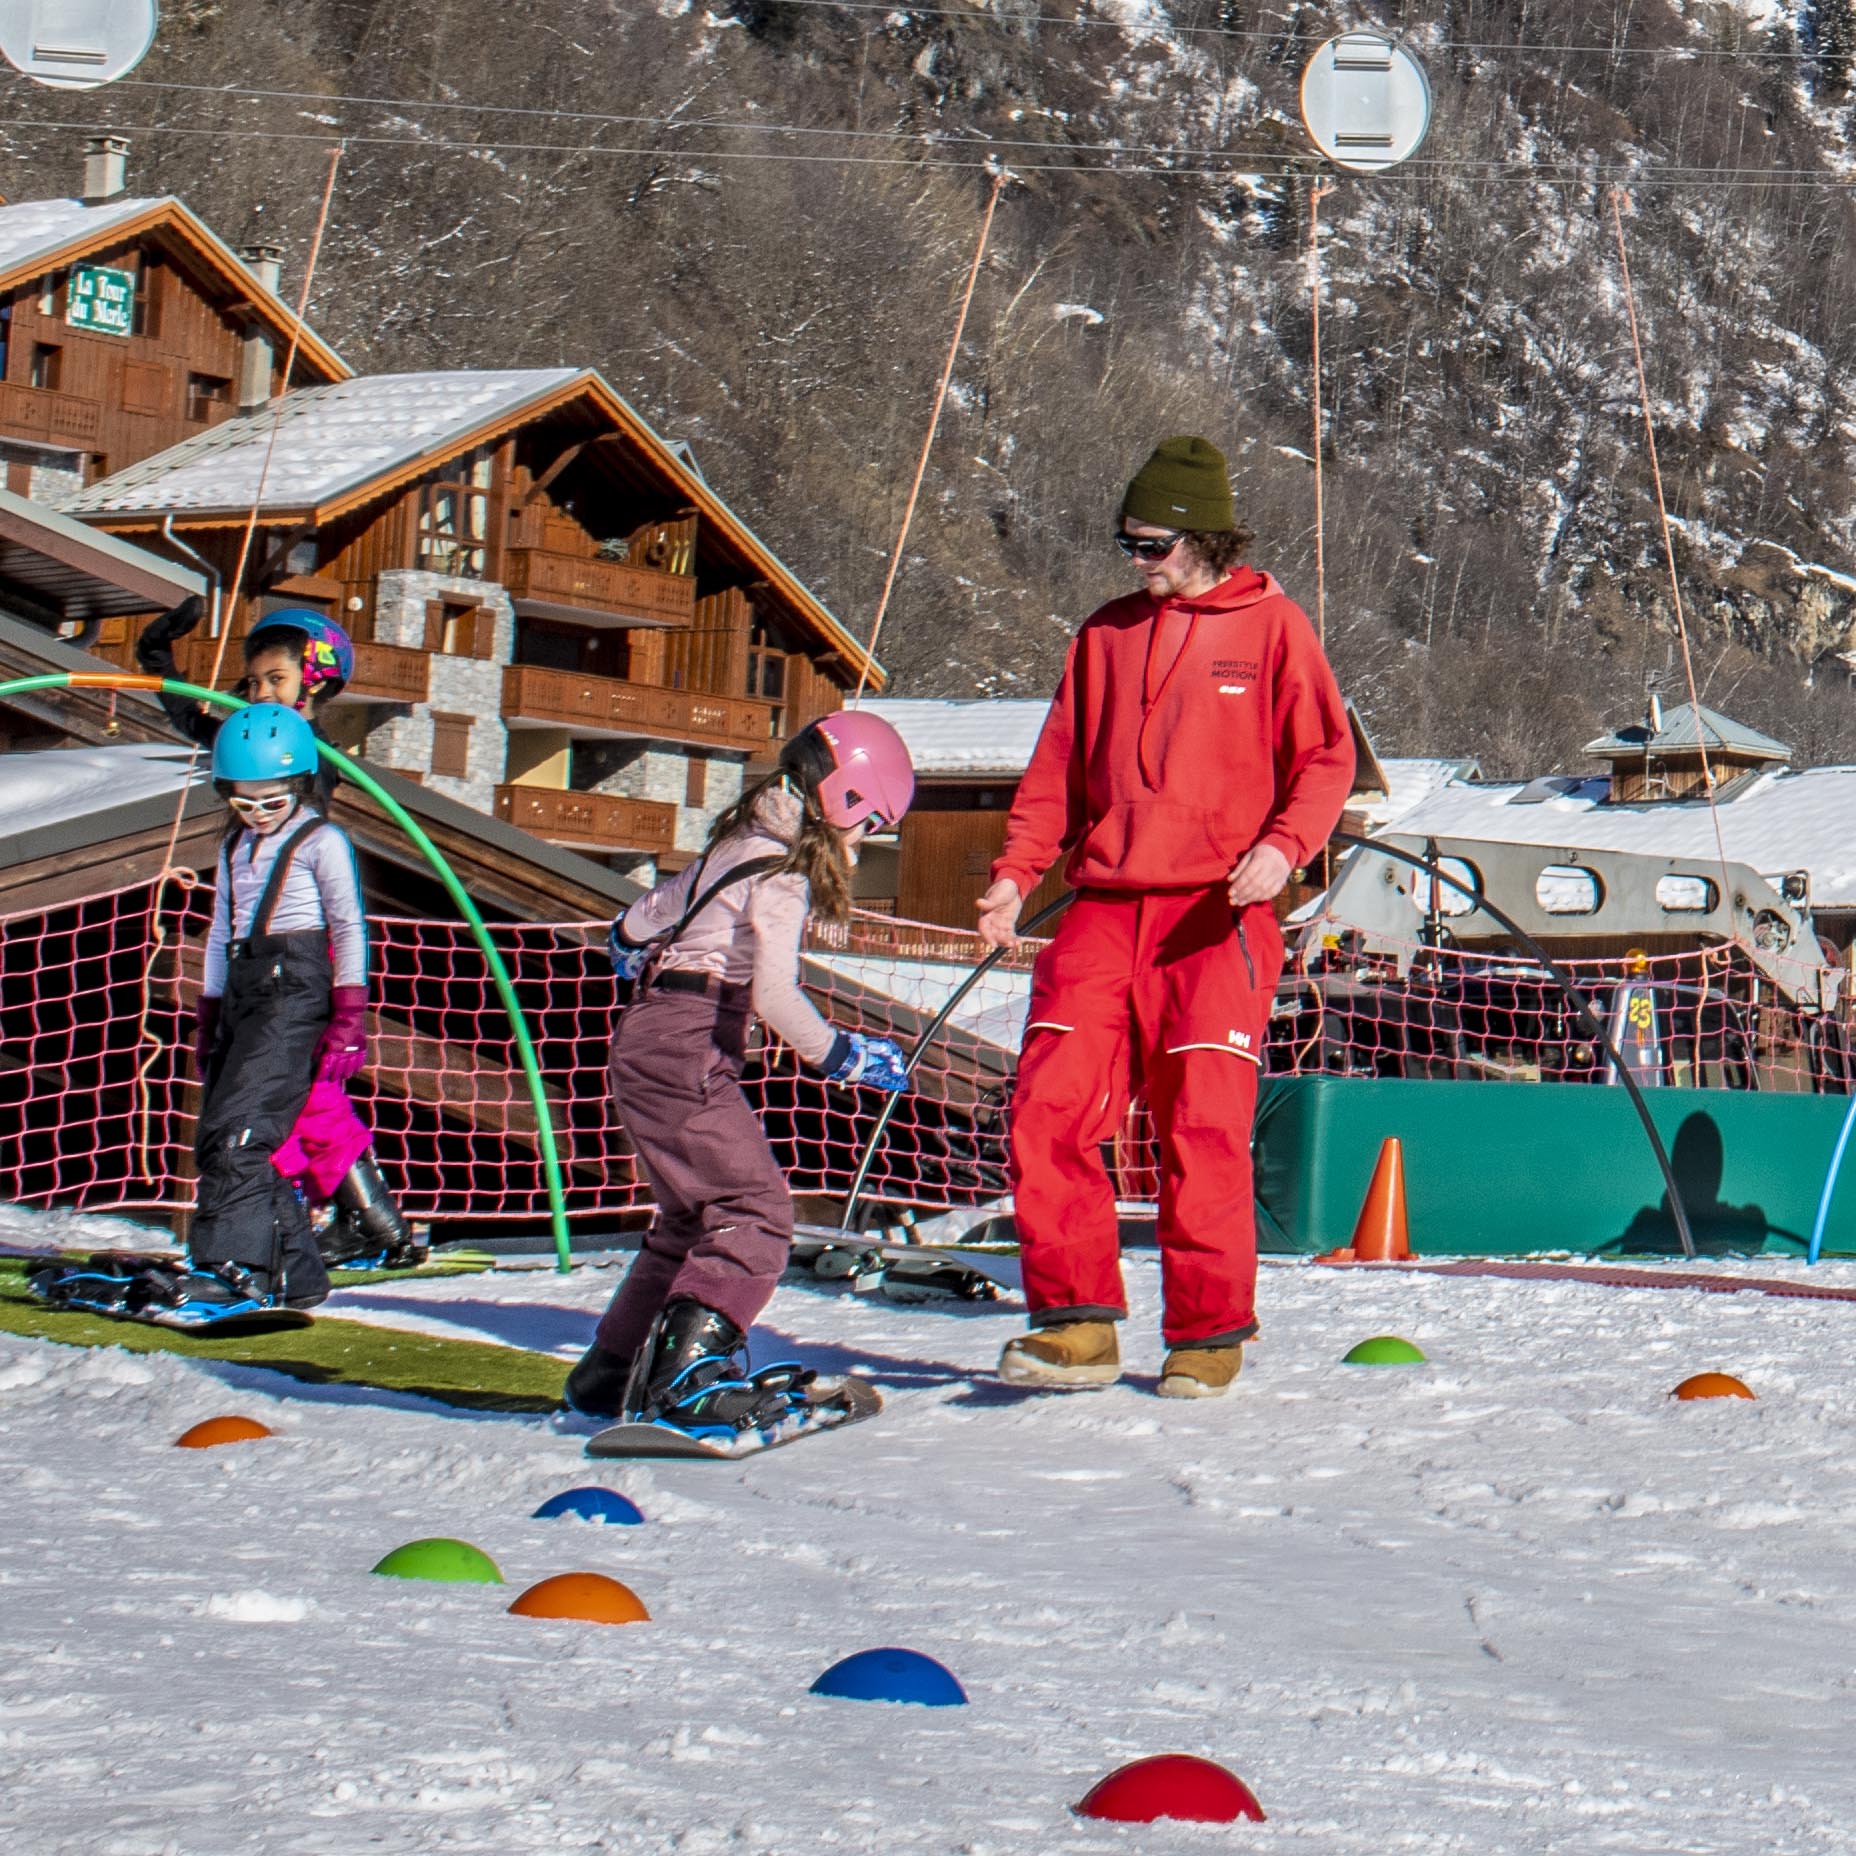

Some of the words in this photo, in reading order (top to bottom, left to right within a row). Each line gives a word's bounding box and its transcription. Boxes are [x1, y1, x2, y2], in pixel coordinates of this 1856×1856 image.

[76, 271, 93, 296] La
[97, 275, 127, 302] Tour
[71, 295, 88, 319] du
[1210, 669, 1257, 680] MOTION
[1629, 997, 1651, 1029] 23
